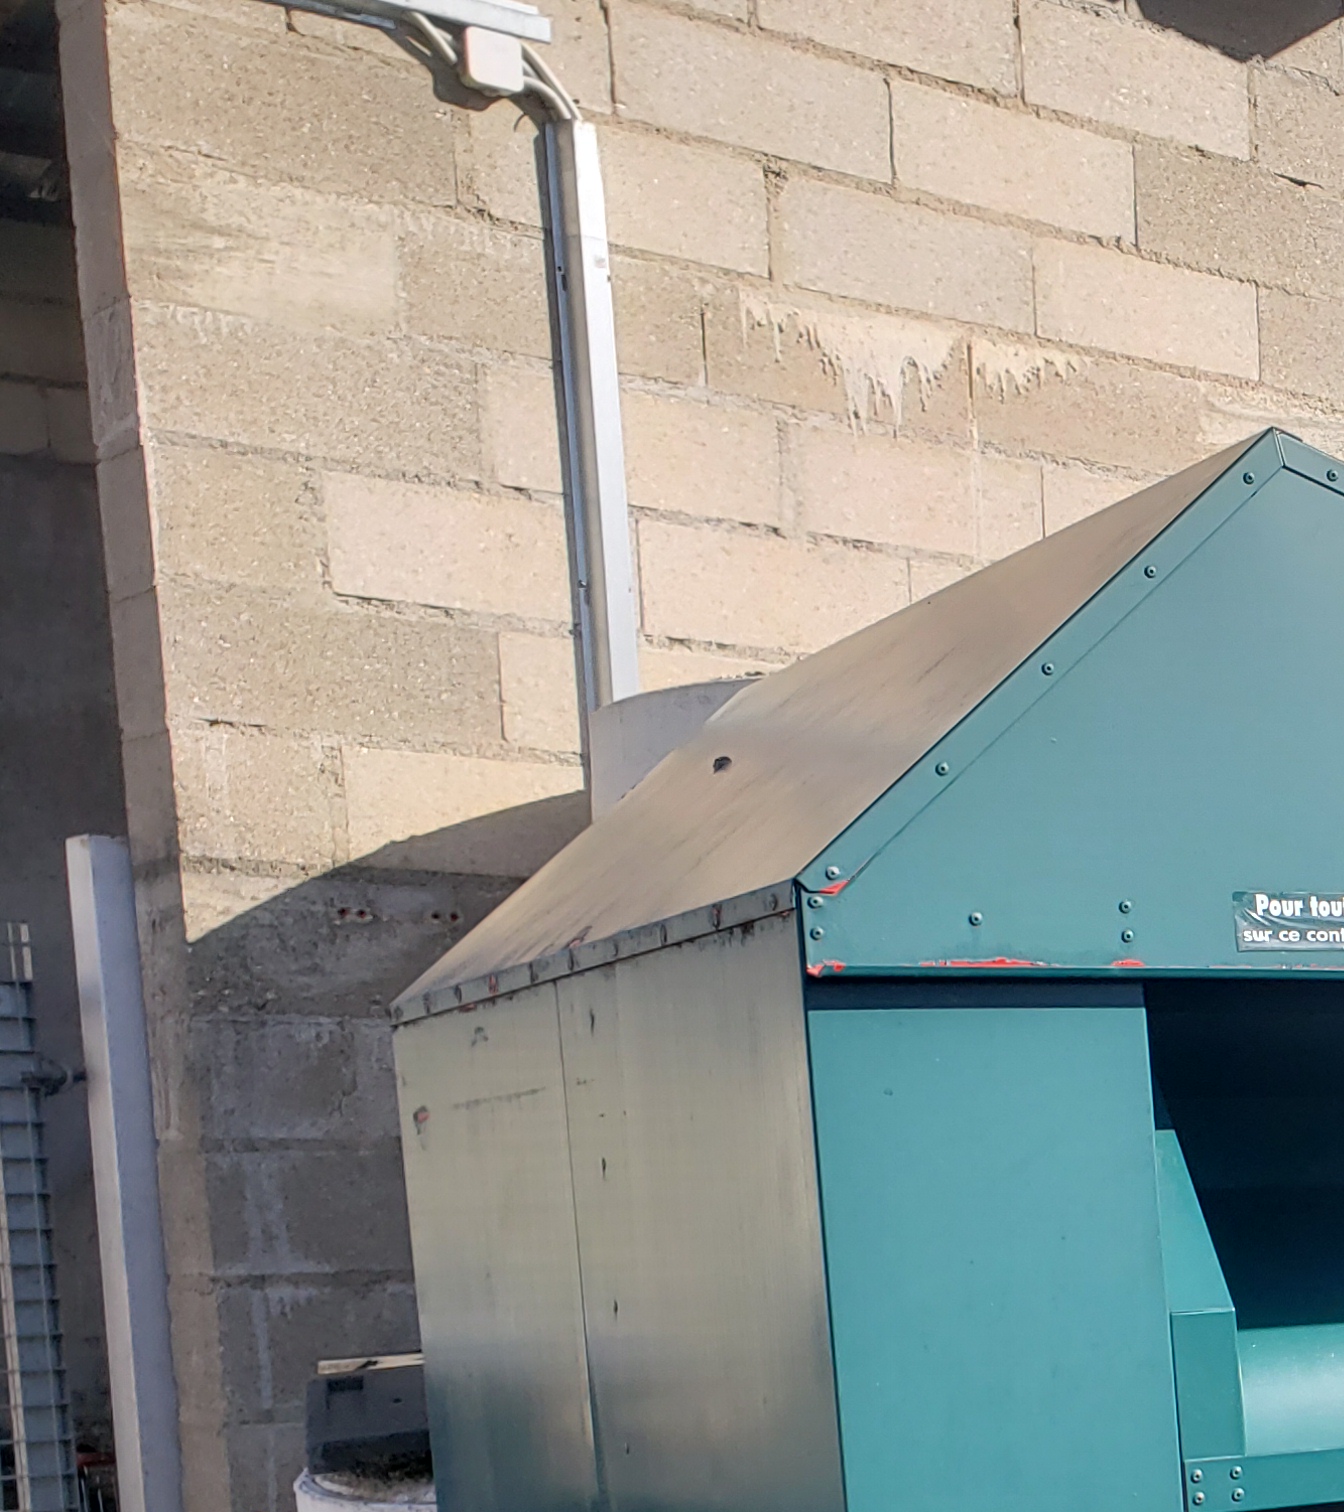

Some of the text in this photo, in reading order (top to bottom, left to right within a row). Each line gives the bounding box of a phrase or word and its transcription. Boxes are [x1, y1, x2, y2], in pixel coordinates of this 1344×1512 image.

[1255, 894, 1301, 916] Pour
[1243, 928, 1272, 942] sur
[1279, 929, 1300, 941] ce
